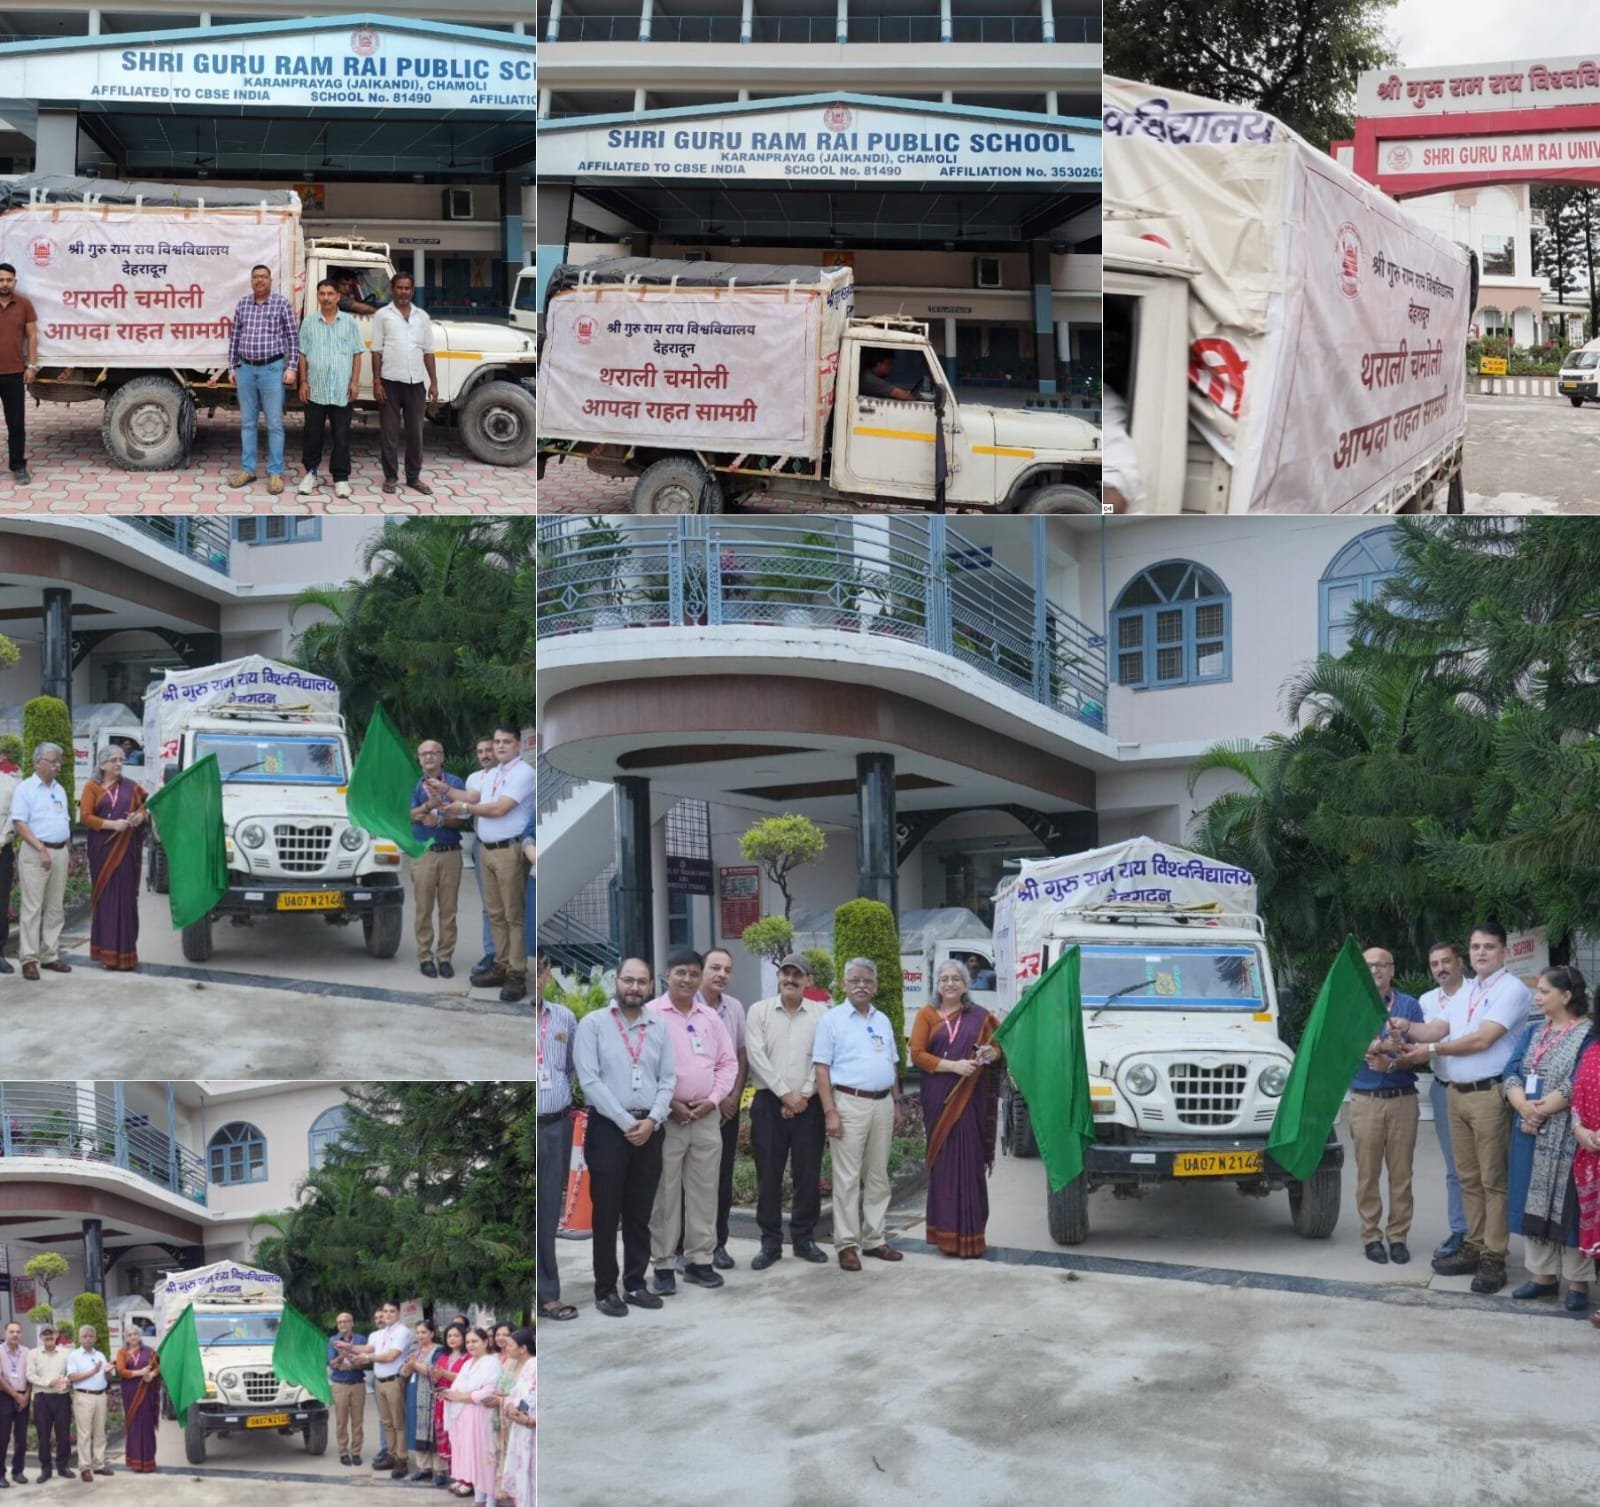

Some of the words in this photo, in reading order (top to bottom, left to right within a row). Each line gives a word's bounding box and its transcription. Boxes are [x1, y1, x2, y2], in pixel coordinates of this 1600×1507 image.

[122, 50, 183, 73] SHRI
[194, 53, 265, 75] GURU
[275, 55, 333, 77] RAM
[343, 56, 387, 78] RAI
[400, 57, 489, 80] PUBLIC
[91, 85, 170, 99] AFFILIATED
[174, 88, 191, 99] TO
[195, 88, 229, 100] CBSE
[233, 89, 270, 101] INDIA
[244, 76, 342, 89] KARANPRAYAG
[346, 78, 423, 91] (JAIKANDI),
[427, 80, 487, 92] CHAMOLI
[1377, 75, 1402, 100] श्री
[1449, 76, 1484, 97] राम
[1489, 73, 1524, 95] राय
[311, 91, 364, 103] SCHOOL
[369, 92, 389, 103] No.
[393, 92, 432, 104] 81490
[608, 129, 665, 150] SHRI
[674, 130, 742, 151] GURU
[751, 131, 807, 151] RAM
[817, 132, 858, 152] RAI
[869, 132, 960, 152] PUBLIC
[970, 133, 1075, 152] SCHOOL
[721, 152, 815, 163] KARANPRAYAG
[818, 152, 894, 165] (JAIKANDI),
[897, 153, 958, 164] CHAMOLI
[1423, 147, 1454, 166] SHRI
[1459, 145, 1497, 165] GURU
[1502, 144, 1533, 163] RAM
[1538, 142, 1562, 161] RAI
[578, 161, 649, 174] AFFILIATED
[653, 163, 671, 174] TO
[674, 163, 707, 175] CBSE
[710, 164, 746, 175] INDIA
[784, 165, 836, 176] SCHOOL
[840, 165, 860, 176] No.
[863, 166, 902, 177] 81490
[939, 166, 1022, 178] AFFILIATION
[1026, 166, 1047, 178] No.
[68, 240, 86, 255] श्री
[88, 243, 107, 259] गुरु
[110, 244, 131, 255] राम
[135, 244, 155, 255] राय
[158, 240, 230, 256] विश्वविद्यालय
[121, 262, 168, 279] देहरादून
[1372, 250, 1385, 278] श्री
[62, 283, 128, 309] थराली
[134, 283, 206, 309] चमोली
[44, 321, 110, 341] आपदा
[116, 322, 165, 344] राहत
[170, 316, 233, 341] सामग्री
[607, 320, 621, 334] श्री
[624, 323, 641, 338] गुरु
[644, 323, 662, 334] राम
[665, 324, 684, 335] राय
[687, 320, 756, 336] विश्वविद्यालय
[653, 340, 696, 358] देहरादून
[1361, 337, 1408, 391] थराली
[1410, 338, 1443, 380] चमोली
[600, 362, 658, 388] थराली
[664, 363, 730, 390] चमोली
[582, 398, 641, 419] आपदा
[645, 401, 690, 423] राहत
[696, 398, 758, 423] सामग्री
[1333, 415, 1392, 470] आपदा
[1393, 403, 1422, 442] राहत
[161, 682, 178, 703] श्री
[211, 676, 235, 692] राम
[238, 671, 259, 686] राय
[1017, 878, 1038, 902] श्री
[1044, 874, 1079, 902] गुरु
[1083, 865, 1114, 887] राम
[1119, 860, 1147, 880] राय
[1184, 1157, 1215, 1172] UA07
[1218, 1157, 1227, 1171] N
